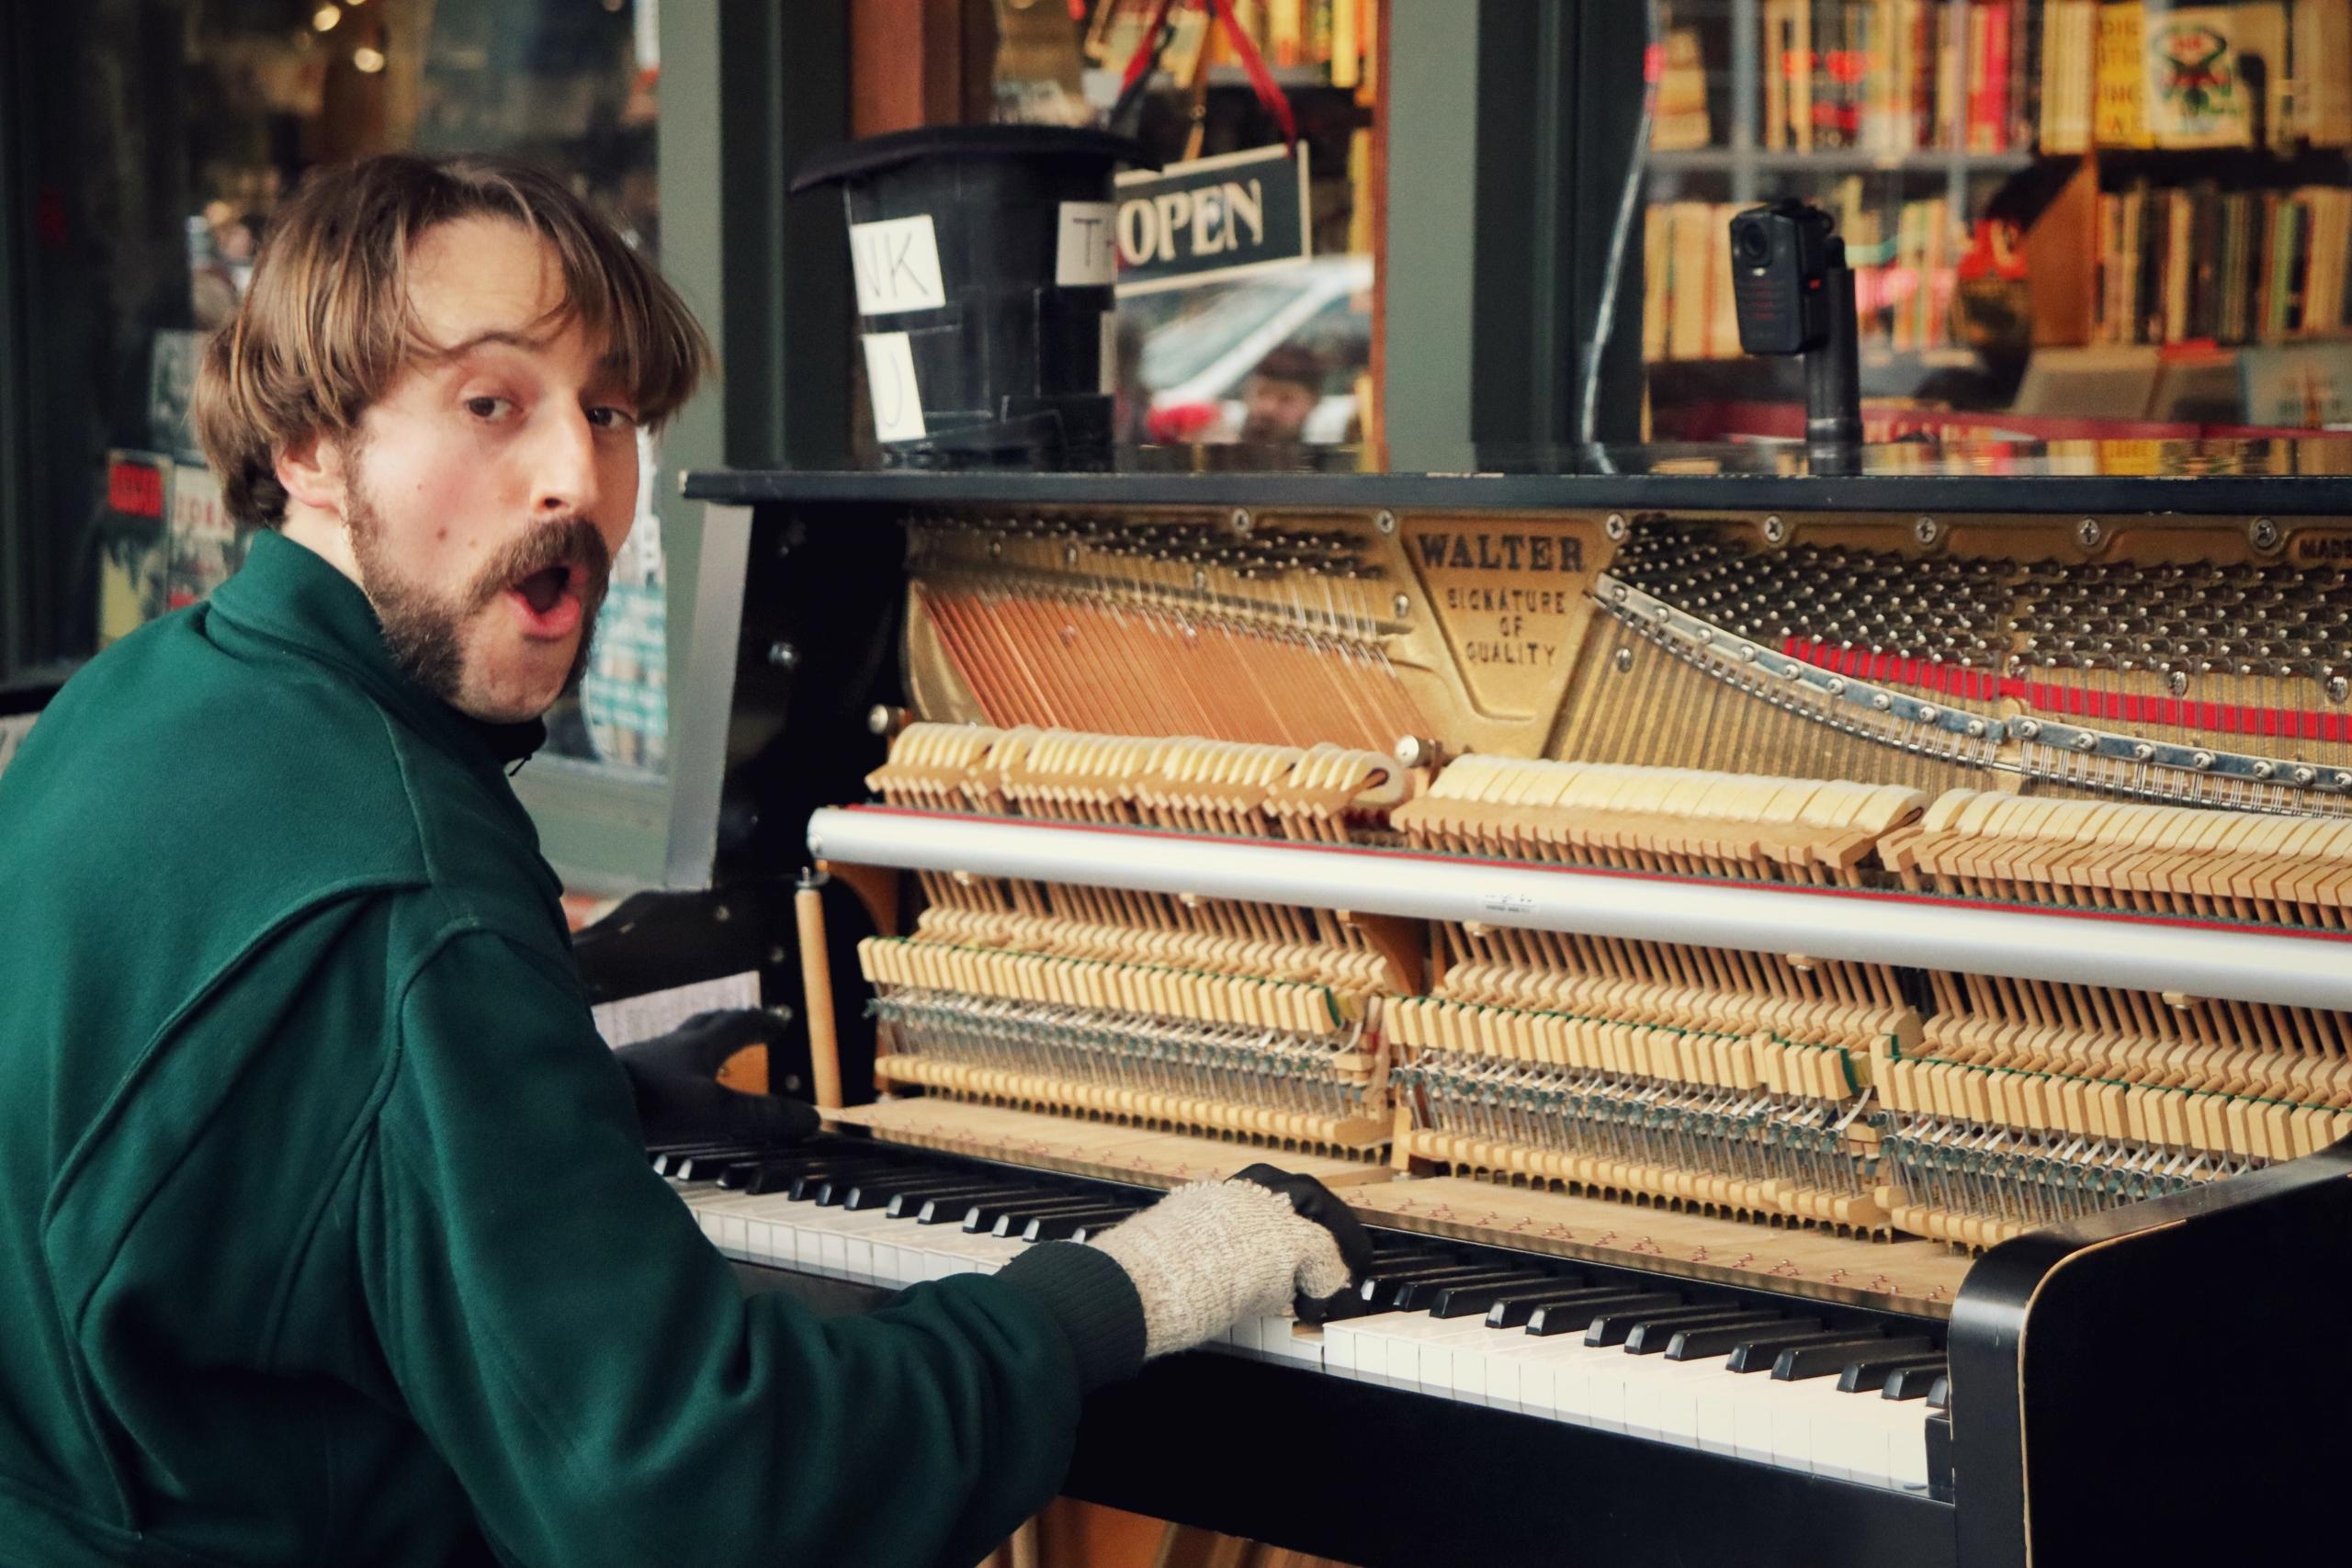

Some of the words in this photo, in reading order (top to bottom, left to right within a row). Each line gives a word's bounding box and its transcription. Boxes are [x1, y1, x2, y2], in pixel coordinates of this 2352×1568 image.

[1118, 178, 1263, 265] OPEN
[1418, 533, 1584, 572] WALTER
[1448, 588, 1566, 615] SIGNATURE
[1499, 616, 1523, 637] OF
[1465, 642, 1555, 665] QUALITY
